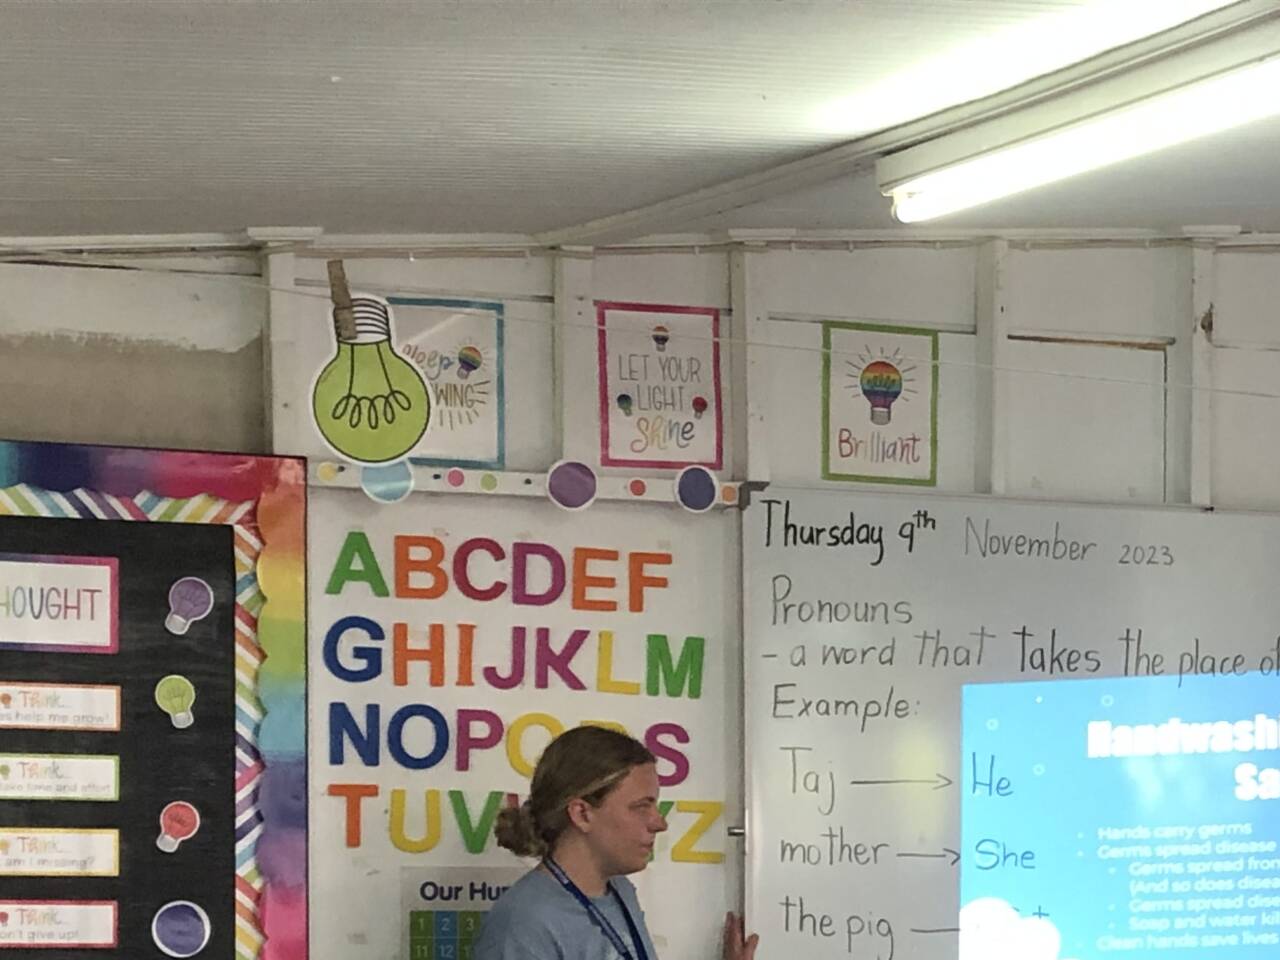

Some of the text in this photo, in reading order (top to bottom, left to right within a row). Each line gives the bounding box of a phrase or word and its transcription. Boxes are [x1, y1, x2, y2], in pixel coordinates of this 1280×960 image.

[618, 354, 701, 383] LET YOUR
[637, 384, 685, 412] LIGHT
[630, 415, 696, 453] Shine
[838, 428, 921, 464] Brilliant
[760, 499, 1175, 566] Thursday 9th November 2023
[771, 574, 913, 625] Pronouns
[789, 647, 807, 668] a
[821, 637, 895, 667] word
[913, 625, 997, 668] that
[1012, 625, 1102, 673] takes
[1117, 628, 1165, 677] the
[1178, 637, 1249, 689] place
[773, 682, 922, 732] Example:
[779, 746, 1014, 816] Taj He
[1098, 825, 1150, 840] Hands
[1198, 823, 1253, 840] germs
[780, 826, 1037, 870] mother She
[1098, 840, 1277, 859] Germs spread disease
[1129, 861, 1185, 876] Germs
[1187, 858, 1244, 875] spread
[420, 881, 464, 901] Our
[1170, 880, 1192, 893] so
[1194, 877, 1234, 892] does
[779, 895, 836, 937] the
[1129, 899, 1184, 913] Germs
[1187, 895, 1244, 912] spread
[441, 918, 451, 931] 2
[465, 918, 474, 932] 3
[1174, 915, 1207, 929] and
[1208, 914, 1257, 928] water
[440, 945, 454, 958] 12
[1147, 933, 1199, 948] hands
[1201, 934, 1240, 947] save
[1242, 931, 1280, 945] lives
